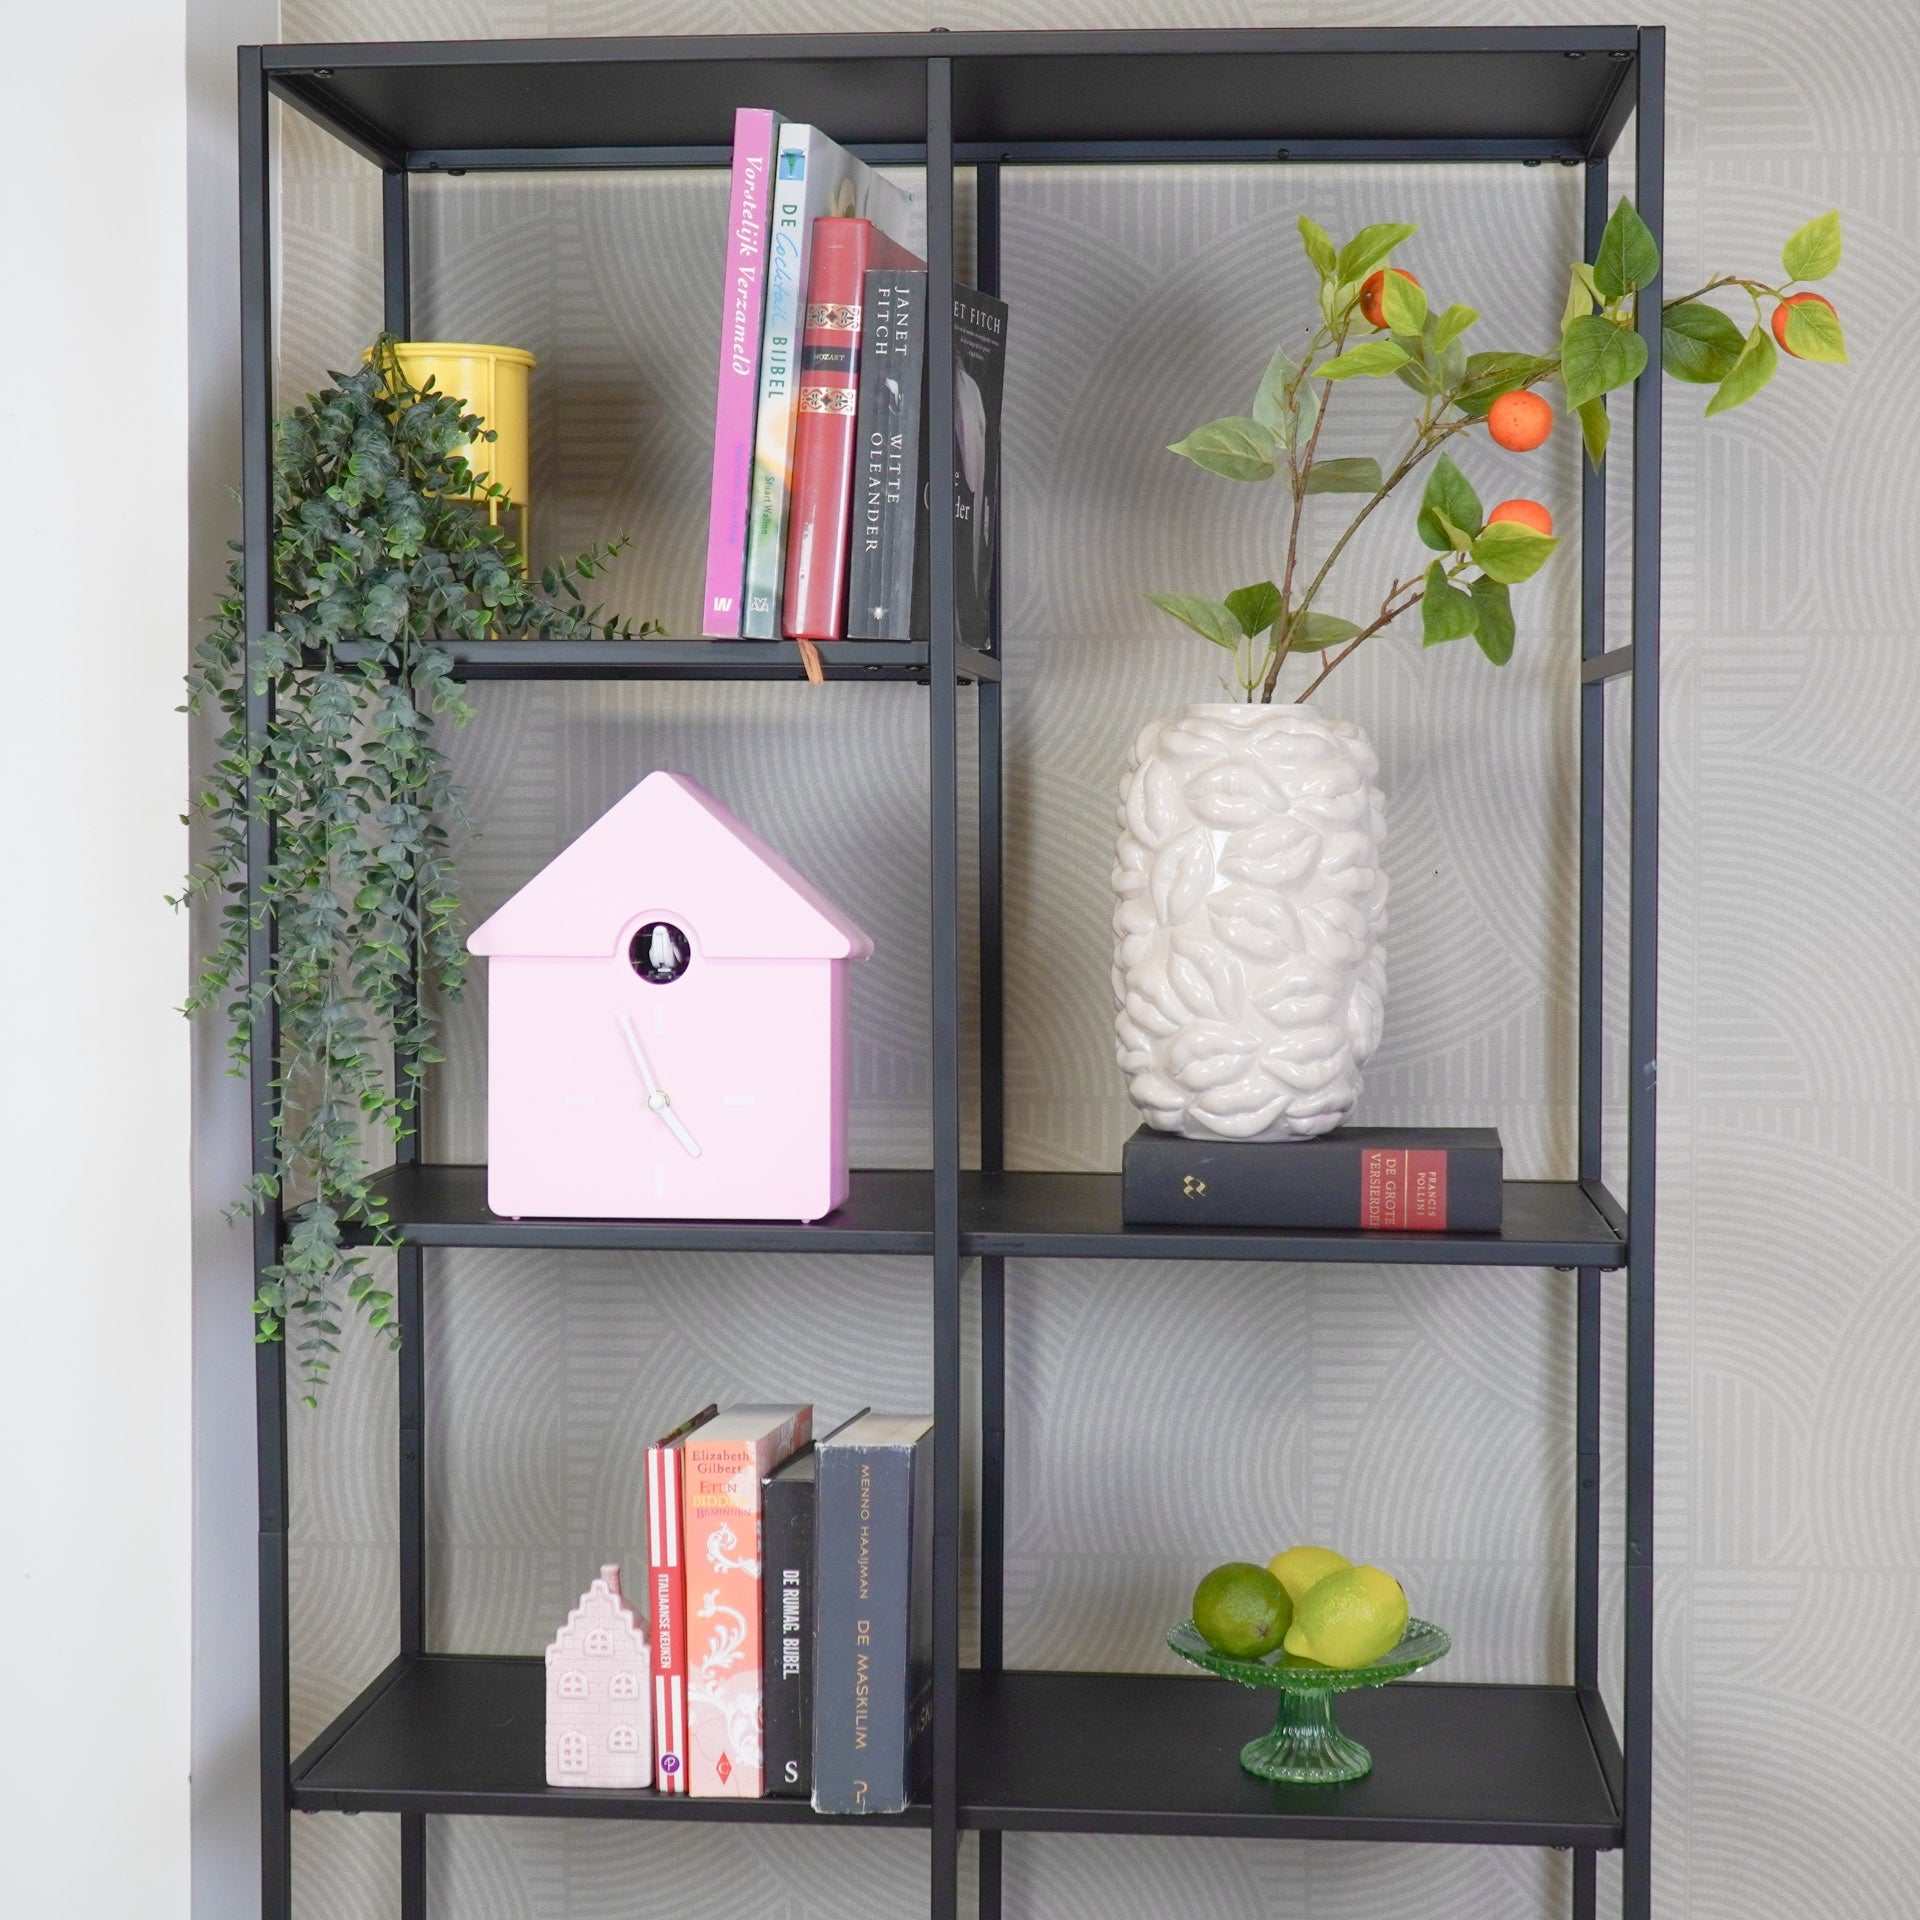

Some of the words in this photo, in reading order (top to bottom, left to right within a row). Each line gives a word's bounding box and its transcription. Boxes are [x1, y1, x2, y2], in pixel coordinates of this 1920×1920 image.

[736, 156, 763, 257] Vorstelijk
[781, 204, 797, 227] DE
[771, 232, 798, 326] Cocktail
[732, 266, 755, 376] Verzameld
[875, 288, 890, 355] FITCH
[895, 286, 909, 356] JANET
[970, 307, 1001, 334] FITCH
[768, 336, 788, 398] BIJBEL
[813, 353, 845, 361] MOZART
[764, 476, 775, 502] Stuart
[887, 433, 902, 503] WITTE
[865, 432, 883, 553] OLEANDER
[761, 504, 773, 535] Walton
[1385, 1159, 1397, 1175] DE
[1384, 1180, 1396, 1225] GROTE
[1416, 1172, 1426, 1215] POLLINI
[1427, 1171, 1437, 1217] FRANCIS
[692, 1450, 750, 1461] Elizabeth
[697, 1463, 742, 1474] Gilbert
[860, 1464, 870, 1520] MENNO
[782, 1570, 799, 1585] DE
[858, 1526, 869, 1599] HAAIJMAN
[657, 1573, 671, 1630] ITALIAANSE
[782, 1588, 800, 1634] RUMAG.
[659, 1630, 671, 1669] KEUKEN
[857, 1620, 870, 1646] DE
[782, 1638, 799, 1680] BIJBEL.
[855, 1653, 869, 1750] MASKILIM
[784, 1761, 798, 1783] S
